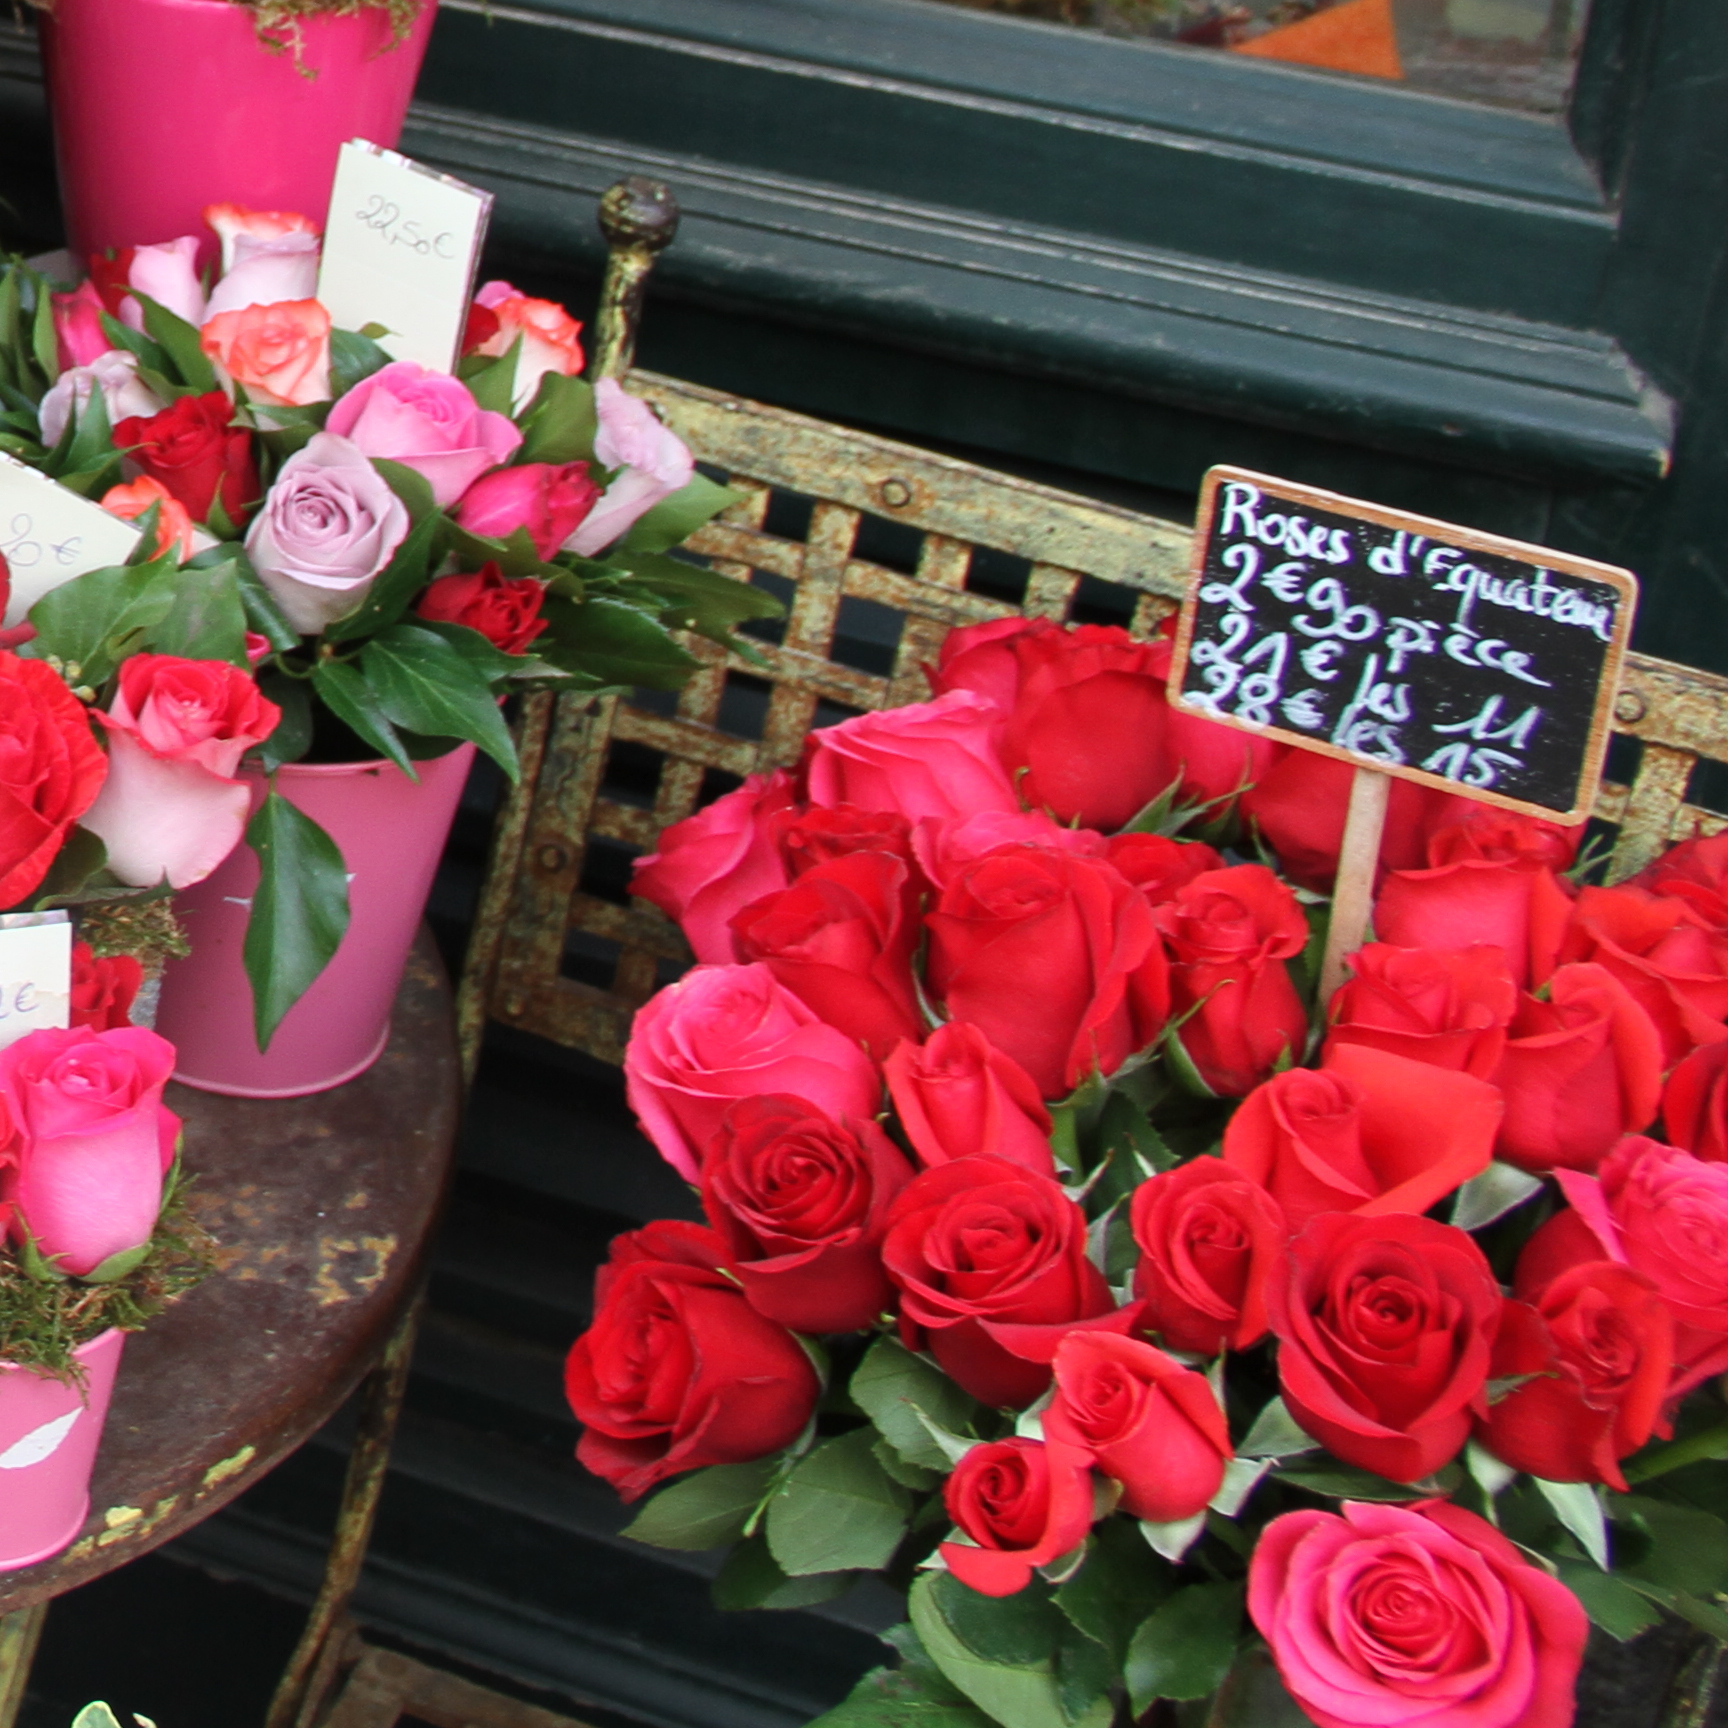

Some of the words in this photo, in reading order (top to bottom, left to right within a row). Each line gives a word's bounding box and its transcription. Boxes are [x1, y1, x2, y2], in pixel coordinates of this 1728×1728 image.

[1219, 481, 1352, 564] Roses
[1385, 615, 1553, 688] pièce
[1350, 652, 1413, 723] les
[1431, 693, 1542, 751] 11
[1420, 741, 1528, 789] 15
